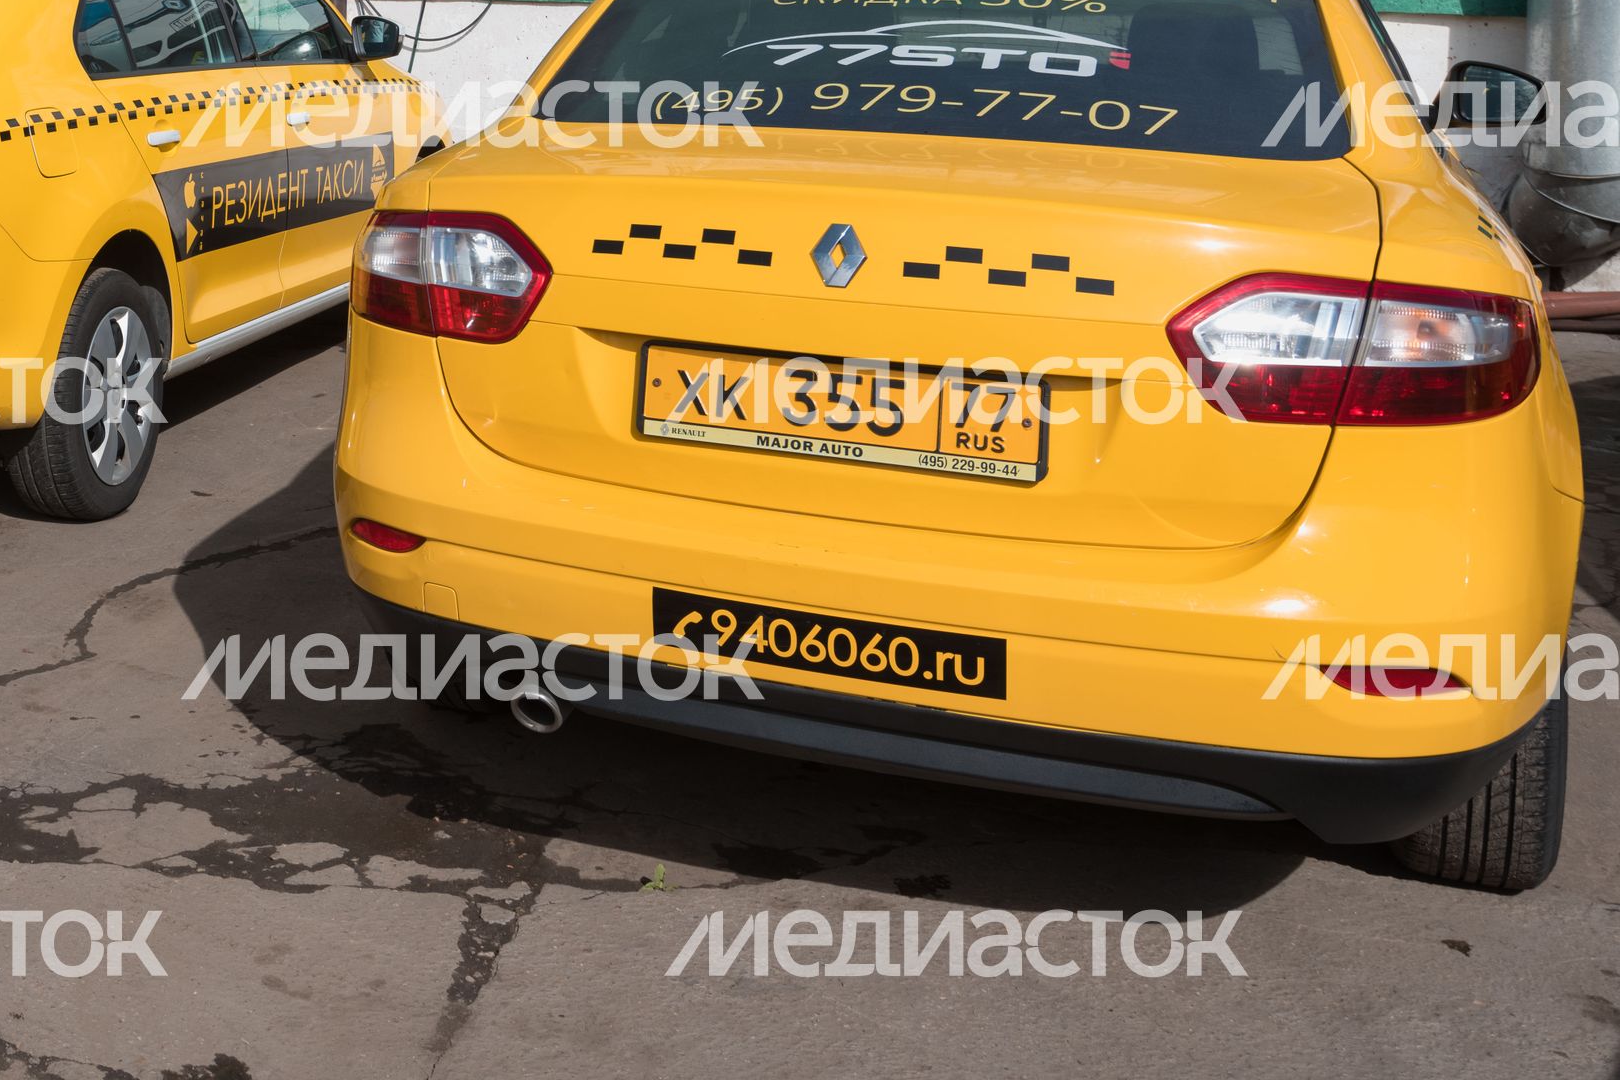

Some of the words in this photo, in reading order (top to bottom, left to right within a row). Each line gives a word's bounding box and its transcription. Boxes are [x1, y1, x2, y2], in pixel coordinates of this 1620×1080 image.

[766, 44, 1097, 77] 77STO
[655, 87, 783, 119] (495)
[811, 83, 1178, 135] 979-77-07
[211, 169, 309, 229] РЕЗИДЕНТ
[315, 159, 365, 205] ТАКСИ
[781, 367, 907, 437] 355
[950, 382, 1017, 433] 77
[671, 427, 706, 438] RENAULT
[755, 435, 816, 453] MAJOR
[819, 442, 864, 458] AUTO
[956, 431, 1005, 454] RUS
[918, 453, 948, 470] (495)
[951, 457, 1018, 477] 229-99-44
[710, 609, 985, 686] 9406060.ru
